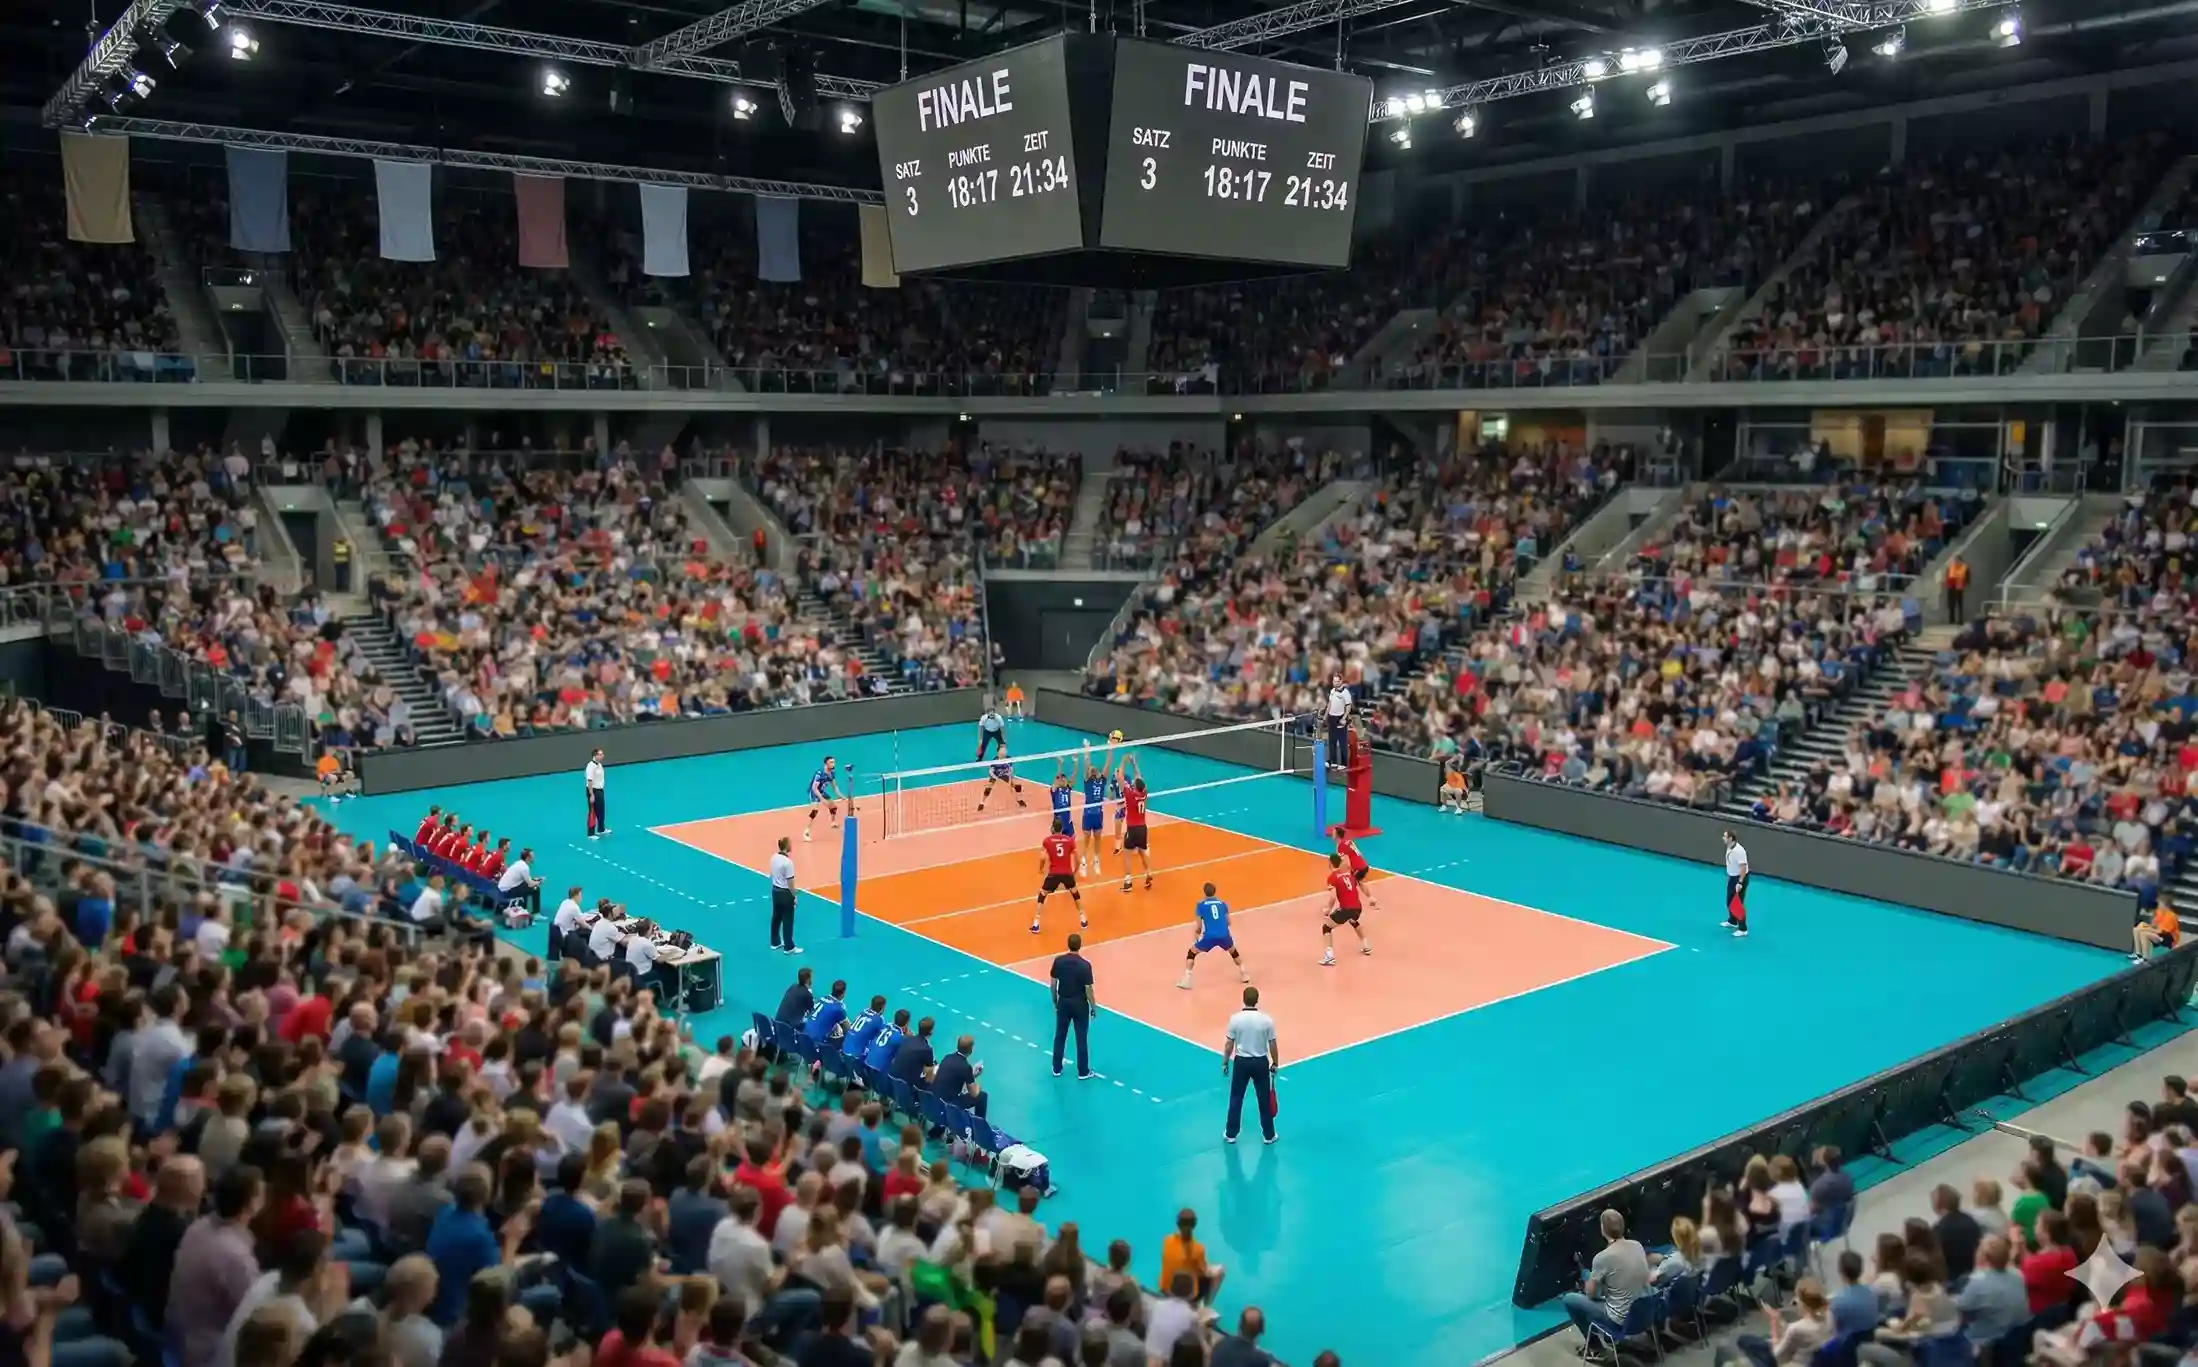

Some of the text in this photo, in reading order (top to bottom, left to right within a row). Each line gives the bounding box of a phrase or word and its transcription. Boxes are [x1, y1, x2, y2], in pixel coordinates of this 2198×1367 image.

[917, 68, 1013, 132] FINALE
[1184, 61, 1309, 122] FINALE
[895, 130, 1049, 180] SATZ PUNKTE ZEIT
[1132, 127, 1336, 170] SATZ PUNKTE ZEIT
[906, 155, 1069, 216] 3 18:17 21:34
[1140, 157, 1348, 211] 3 18:17 21:34
[1055, 843, 1065, 857] 5
